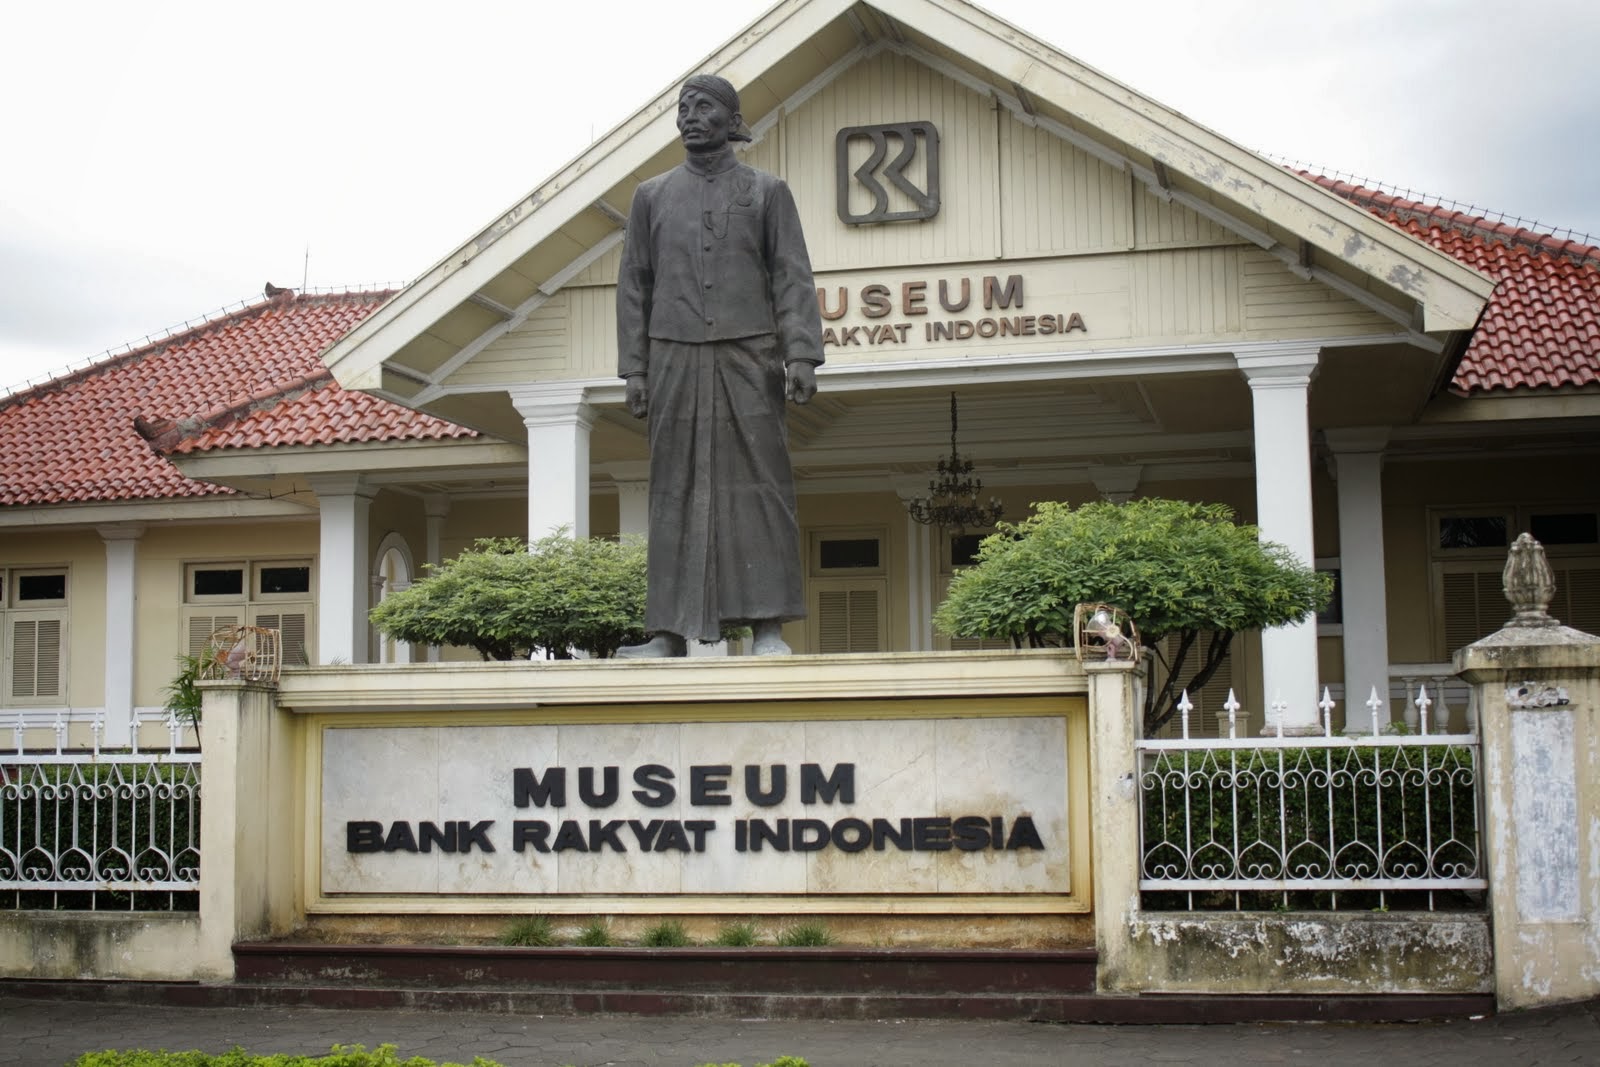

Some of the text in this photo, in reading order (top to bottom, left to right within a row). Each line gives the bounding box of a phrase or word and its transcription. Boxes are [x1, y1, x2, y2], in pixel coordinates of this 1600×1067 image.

[817, 275, 1024, 321] USEUM
[822, 312, 1087, 347] AKYAT INDONESIA
[513, 763, 855, 808] MUSEUM
[347, 816, 1045, 853] BANK RAKYAT INDONESIA
